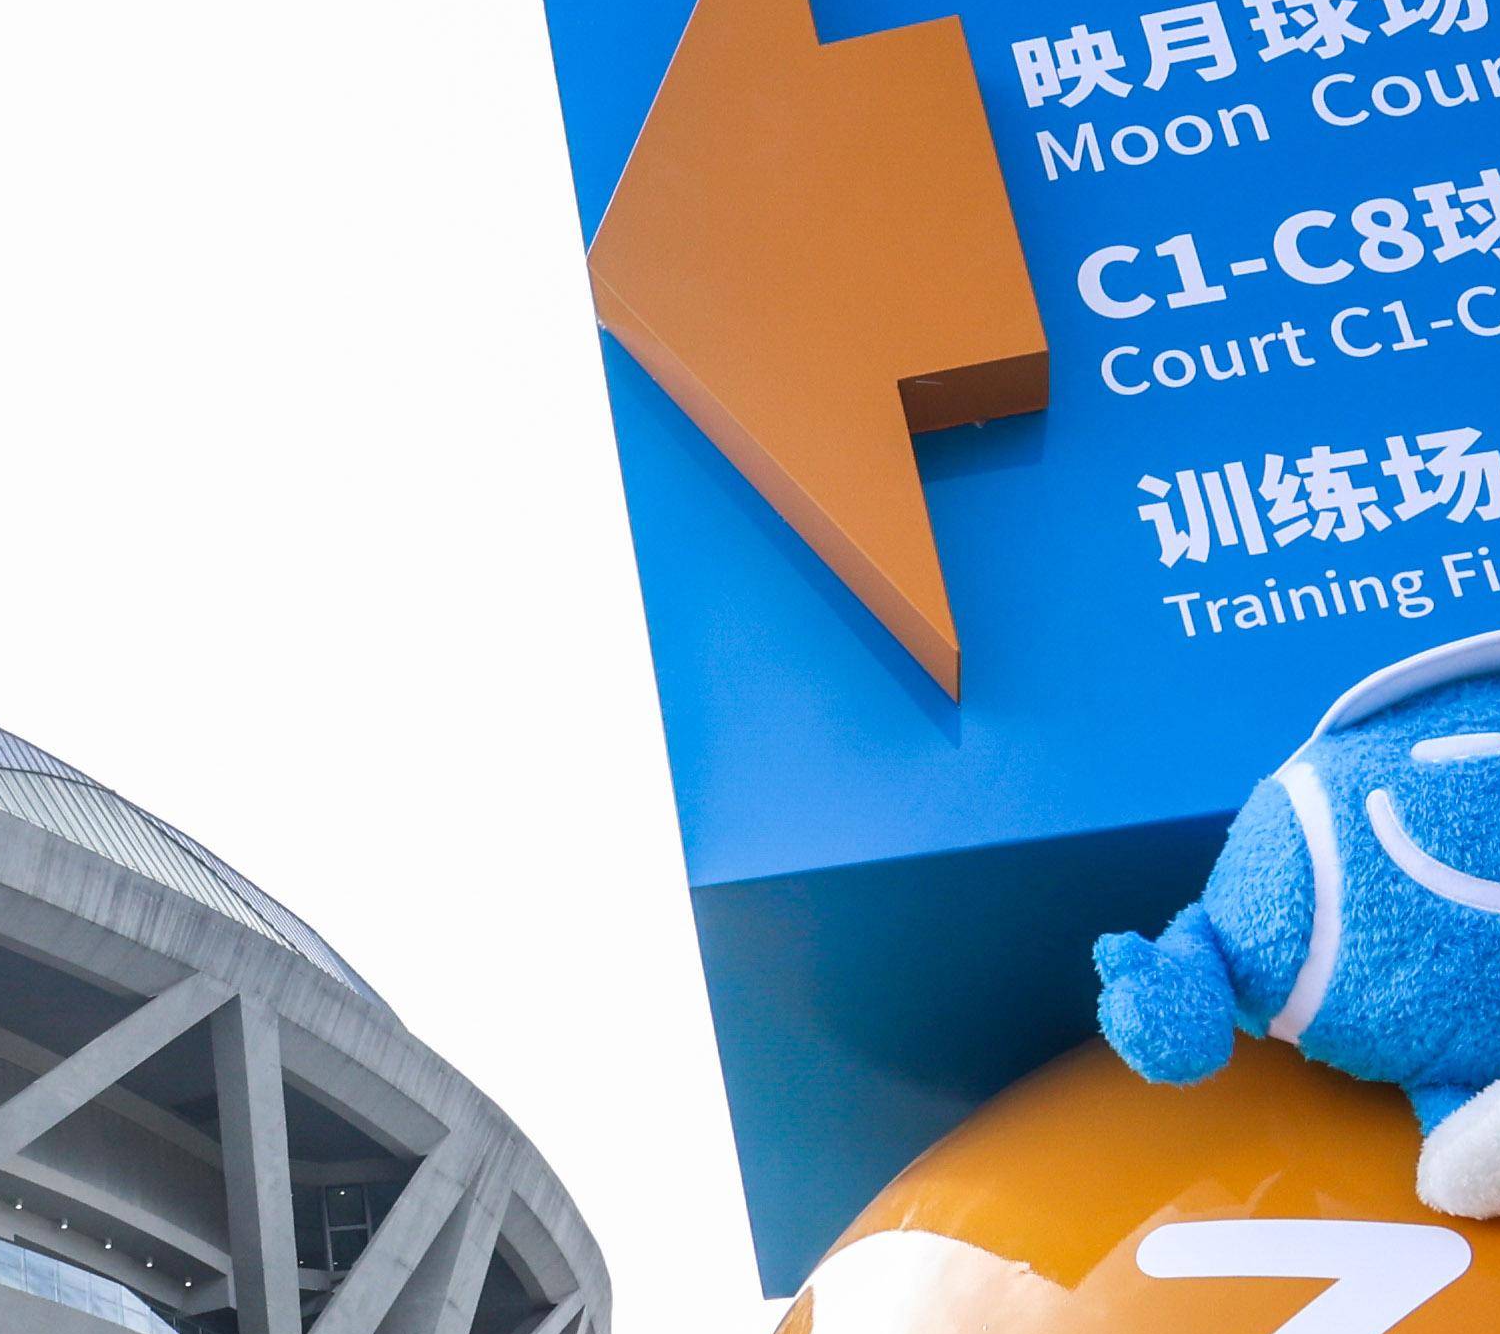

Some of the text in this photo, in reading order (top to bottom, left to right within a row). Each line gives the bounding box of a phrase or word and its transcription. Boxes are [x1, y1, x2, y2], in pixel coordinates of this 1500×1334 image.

[1037, 104, 1270, 181] Moon
[1102, 322, 1315, 396] Court
[1163, 570, 1435, 638] Training
